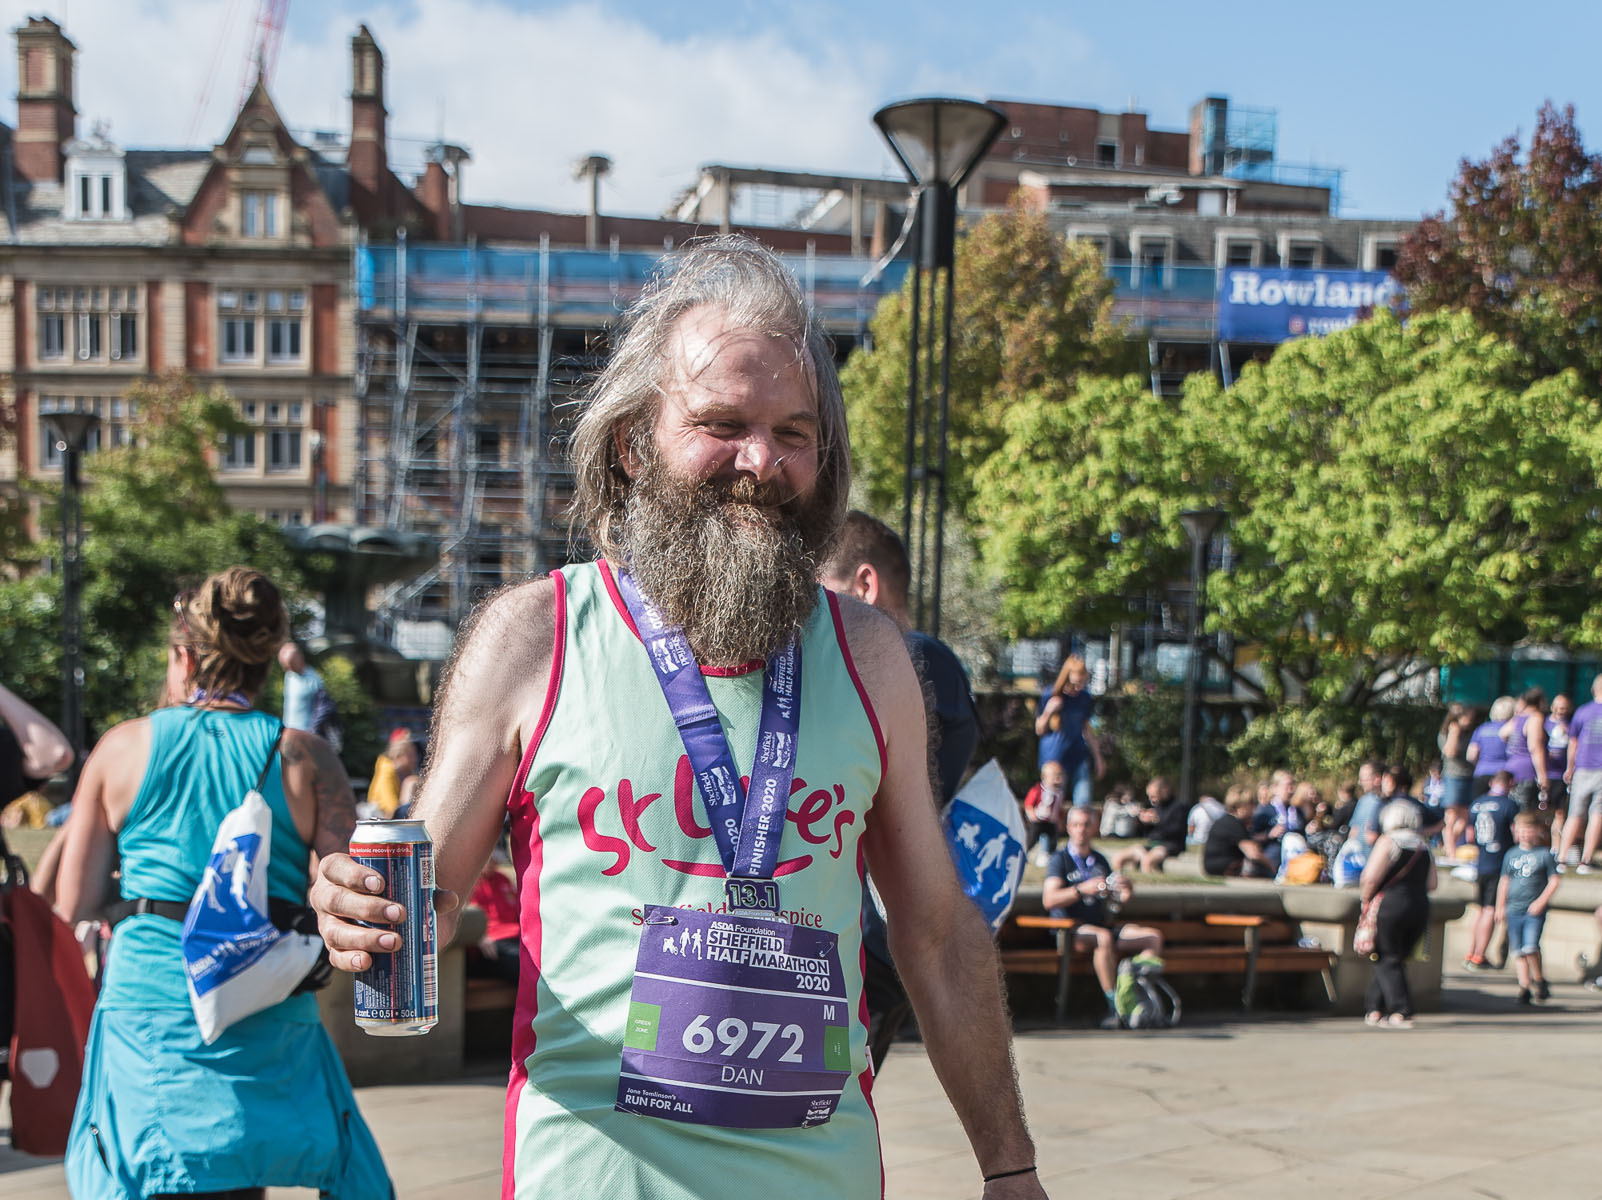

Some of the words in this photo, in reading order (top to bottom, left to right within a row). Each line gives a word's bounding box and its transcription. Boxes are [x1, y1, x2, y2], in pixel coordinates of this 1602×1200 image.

[672, 635, 690, 666] Sheffield
[777, 656, 786, 695] SHEFFIELD
[785, 679, 793, 697] HALF
[761, 731, 773, 763] Sheffield
[700, 772, 718, 806] Sheffield
[725, 818, 740, 853] 020
[749, 815, 770, 875] FINISHER
[762, 779, 777, 812] 2020
[729, 884, 777, 908] 13.1
[710, 921, 734, 931] ASDA
[735, 924, 775, 936] Foundation
[708, 931, 783, 952] SHEFFIELD
[706, 947, 749, 965] HALF
[751, 952, 828, 975] MARATHON
[796, 974, 830, 992] 2020
[823, 1004, 835, 1021] M
[682, 1014, 805, 1063] 6972
[721, 1066, 764, 1086] DAN
[625, 1094, 648, 1107] RUN
[650, 1097, 671, 1111] FOR
[674, 1102, 693, 1113] ALL
[627, 1087, 641, 1096] Jane
[642, 1089, 677, 1100] Tomlinson's
